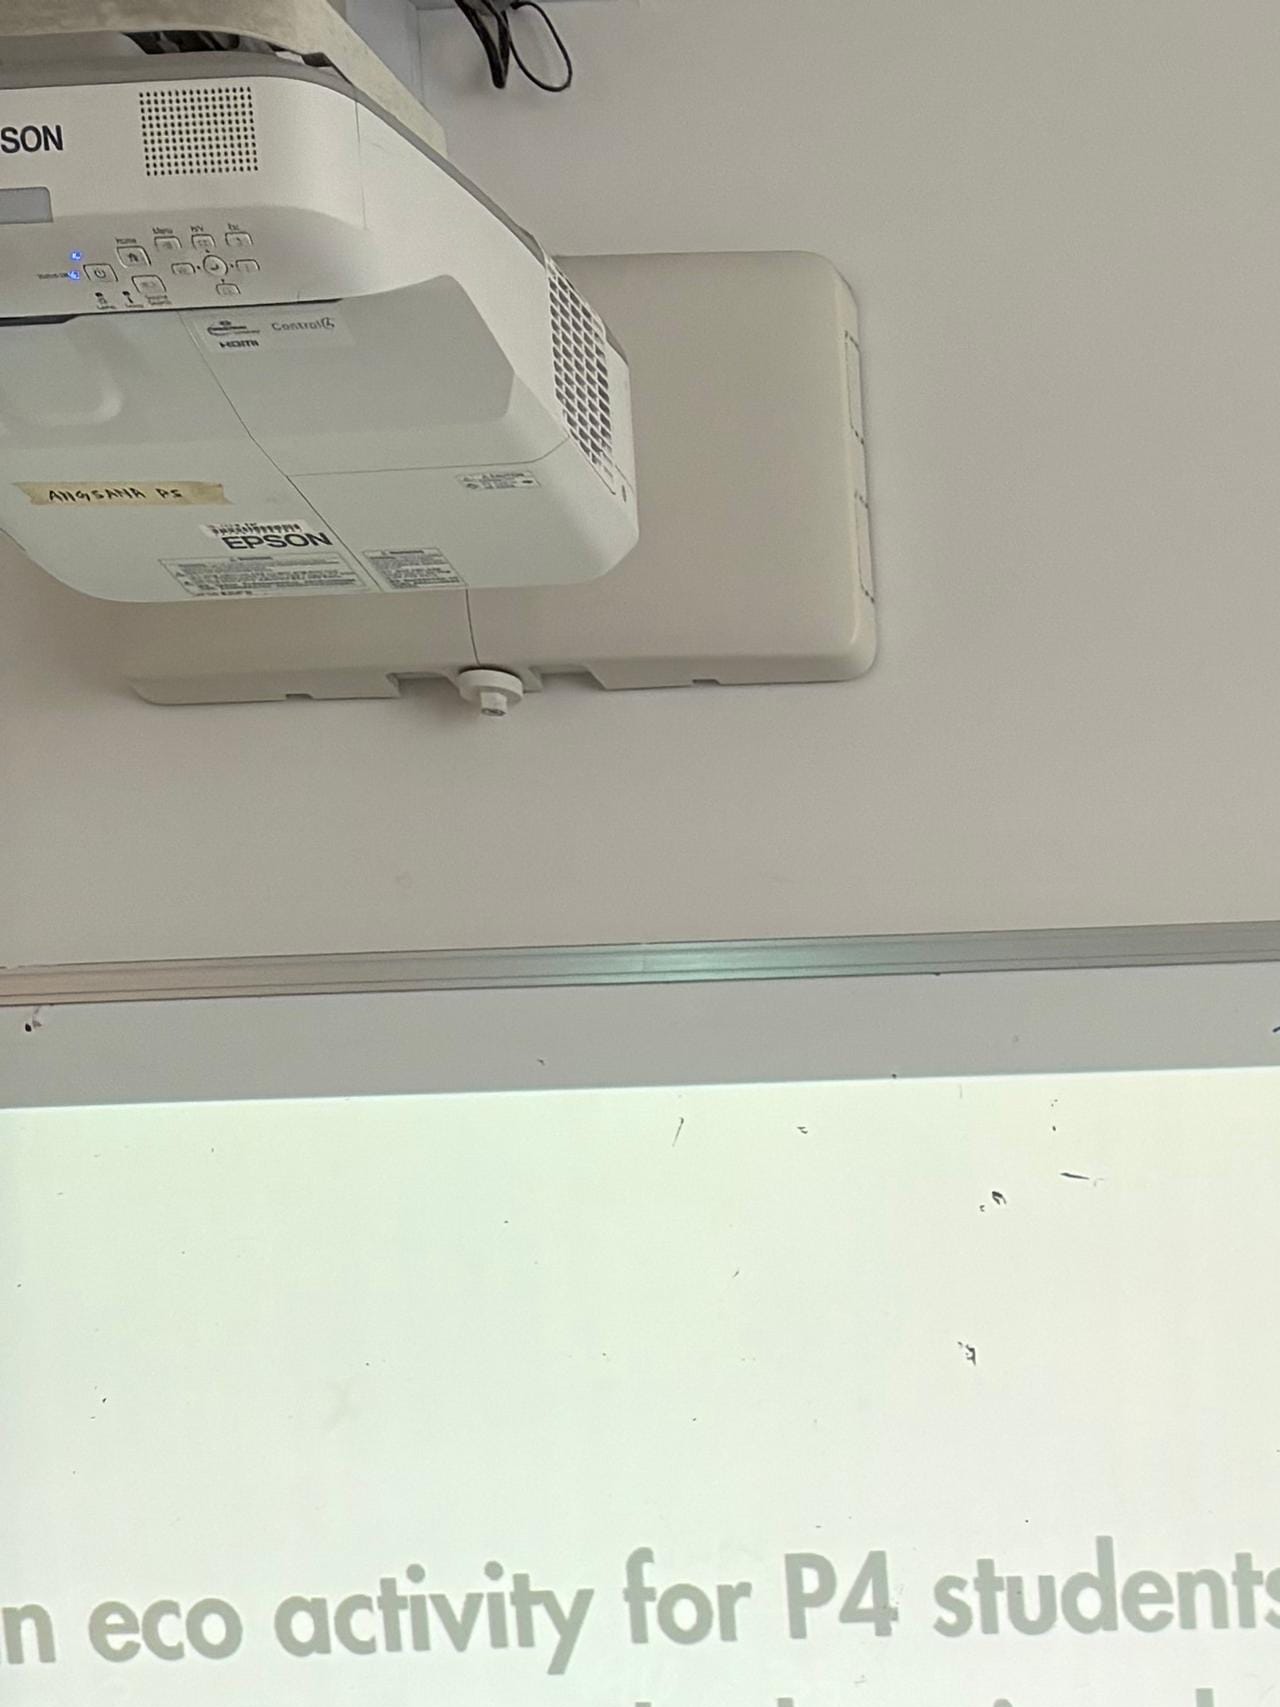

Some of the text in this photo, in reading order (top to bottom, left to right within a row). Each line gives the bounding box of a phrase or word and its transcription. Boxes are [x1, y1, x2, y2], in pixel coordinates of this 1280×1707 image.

[222, 532, 333, 550] EPSON
[88, 1598, 243, 1663] eco
[274, 1560, 594, 1675] activity
[623, 1547, 752, 1645] for
[784, 1550, 898, 1640] P4
